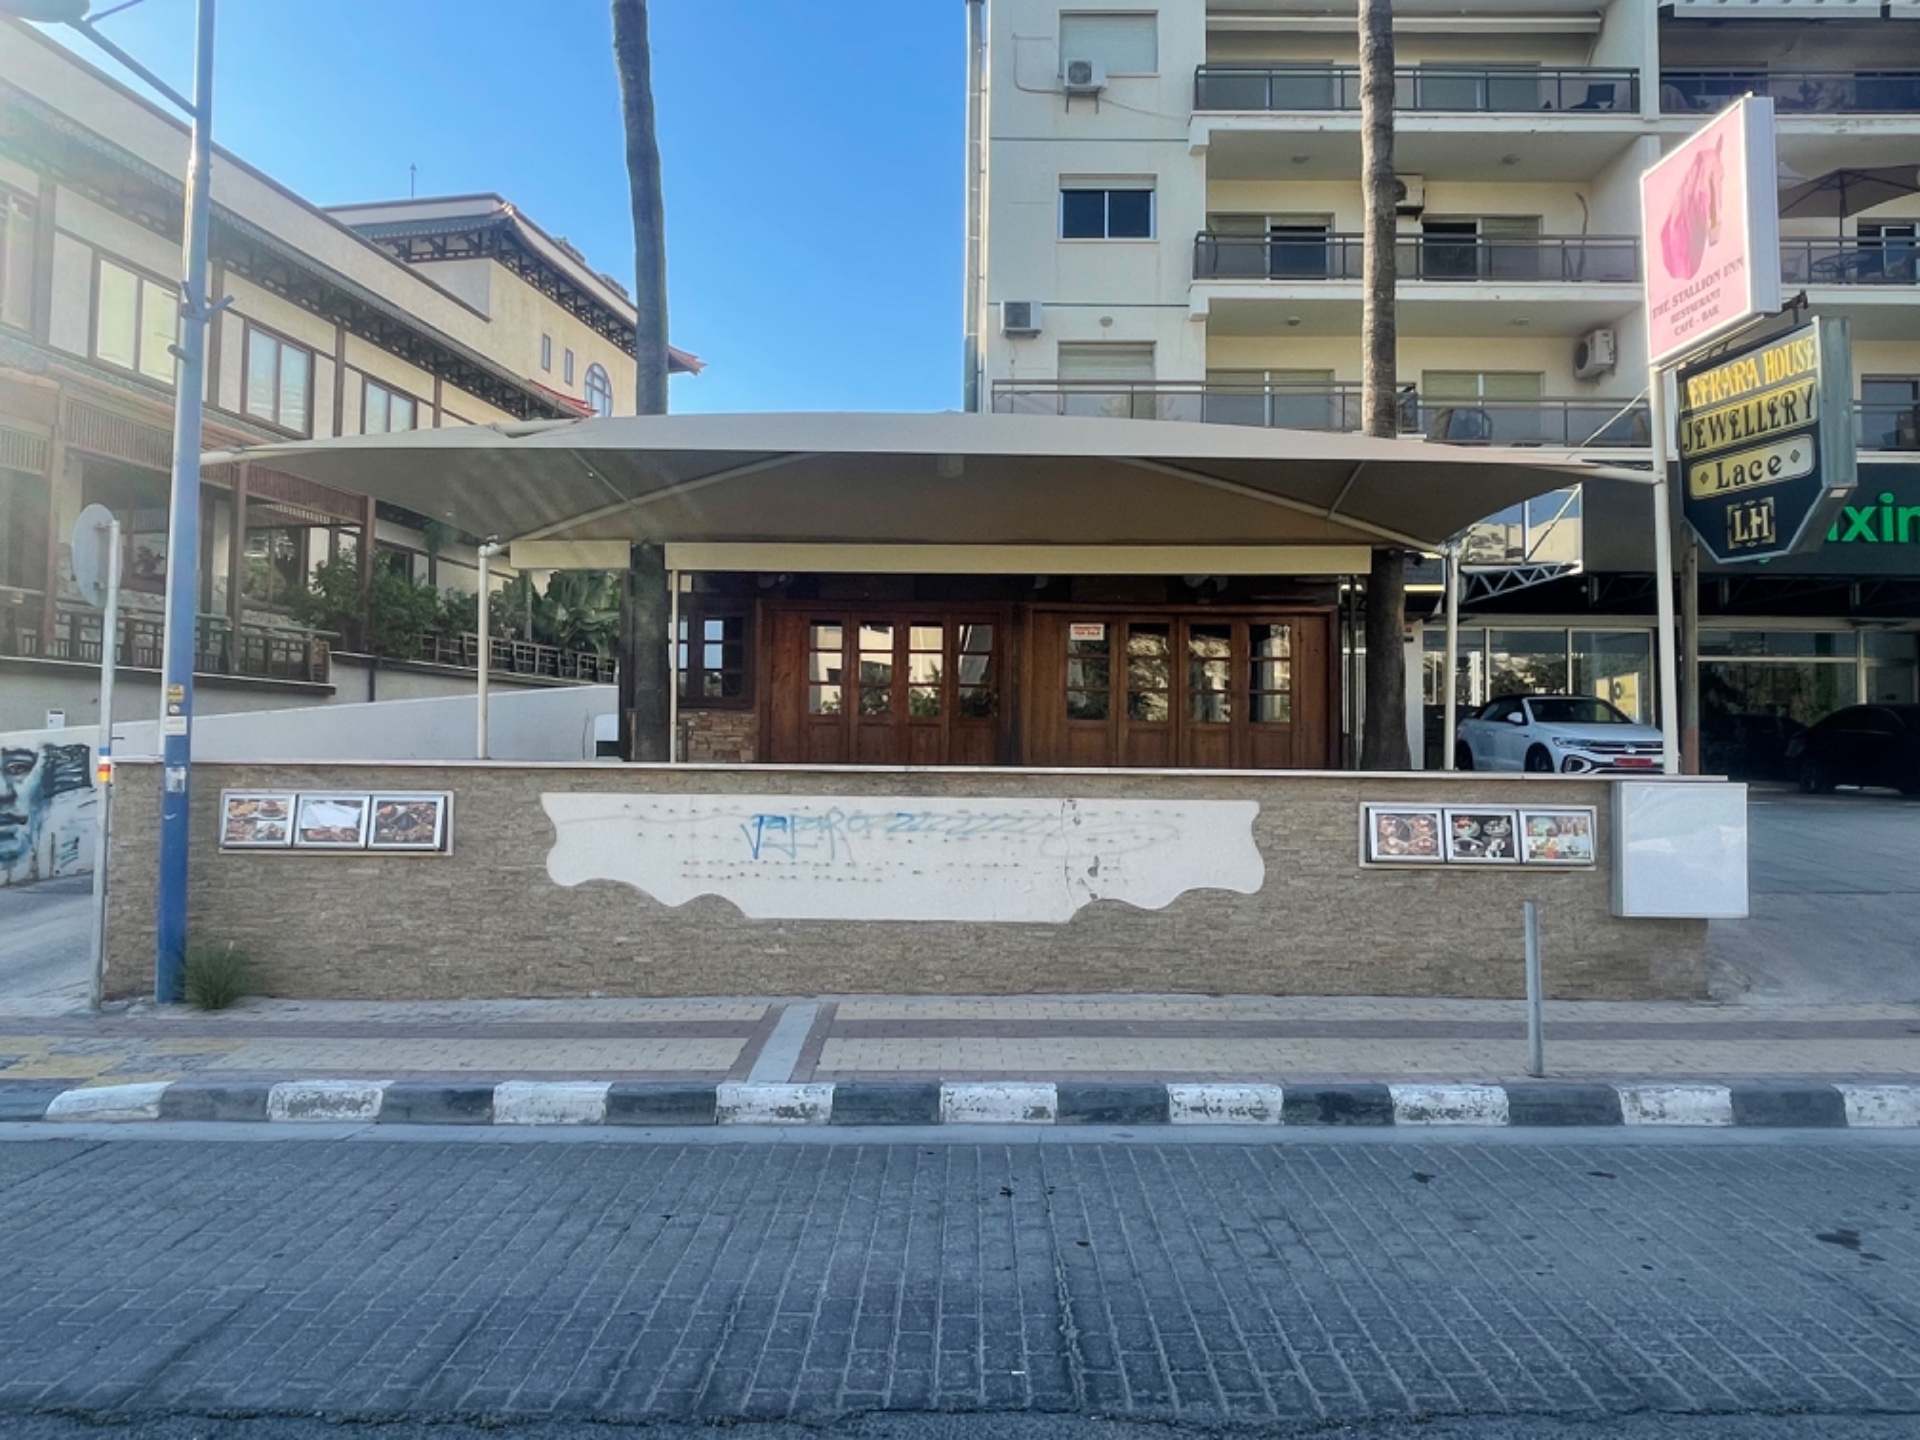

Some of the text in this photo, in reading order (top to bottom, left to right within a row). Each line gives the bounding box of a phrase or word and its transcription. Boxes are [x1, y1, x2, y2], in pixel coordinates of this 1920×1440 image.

[1651, 256, 1744, 319] THE STALLION INN
[1701, 304, 1719, 322] BAR
[1762, 335, 1817, 384] HOUSE
[1683, 383, 1816, 451] JEWELLERY
[1716, 454, 1782, 490] Lace
[1733, 504, 1770, 543] LH
